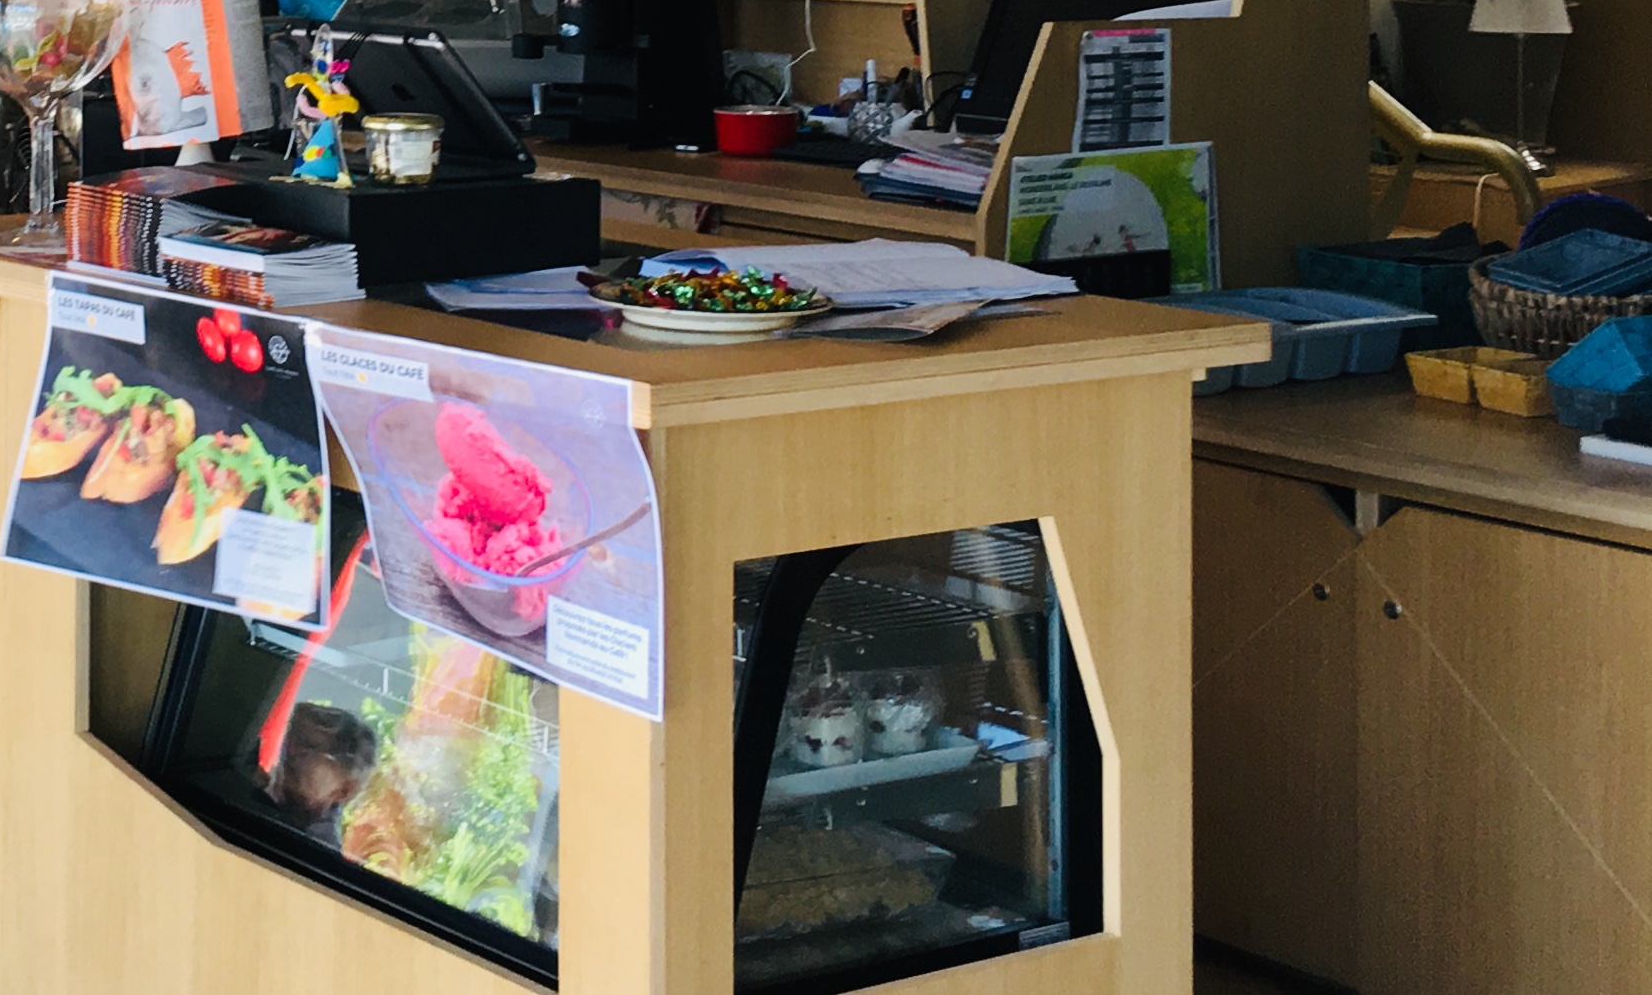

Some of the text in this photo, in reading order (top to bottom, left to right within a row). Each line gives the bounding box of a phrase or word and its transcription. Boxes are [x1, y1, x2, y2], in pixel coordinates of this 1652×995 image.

[57, 295, 74, 309] LES
[321, 349, 425, 380] LES GLACES DU CAFÉ
